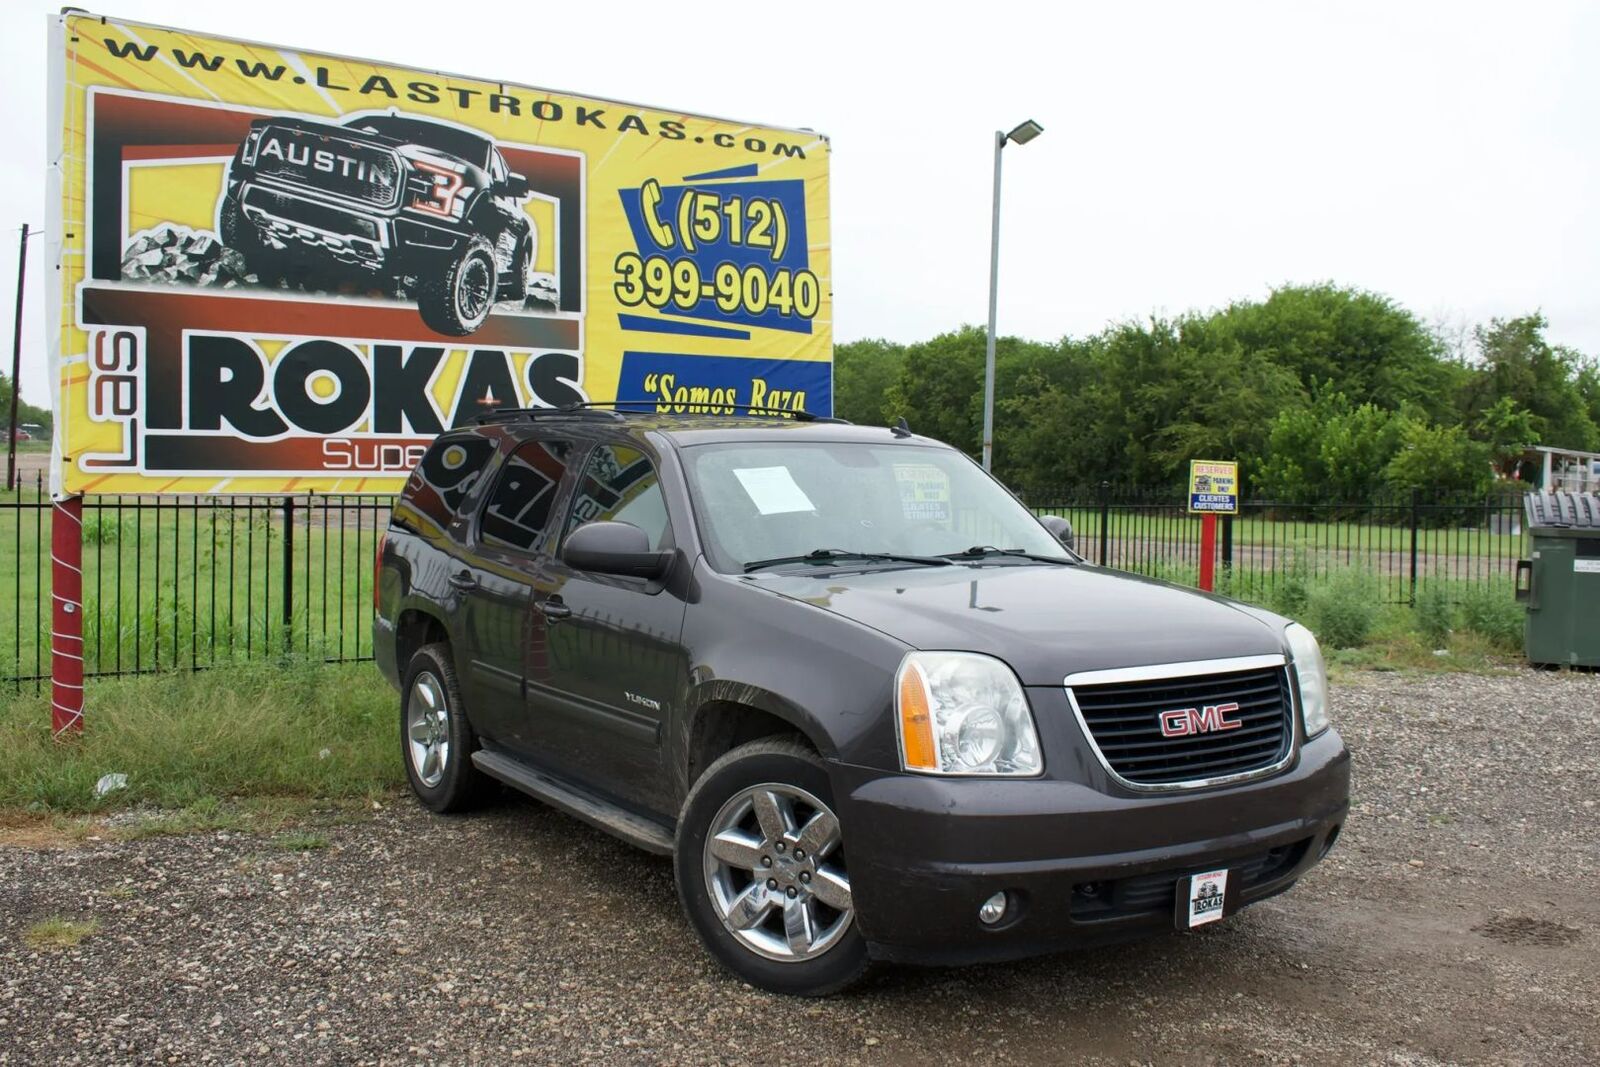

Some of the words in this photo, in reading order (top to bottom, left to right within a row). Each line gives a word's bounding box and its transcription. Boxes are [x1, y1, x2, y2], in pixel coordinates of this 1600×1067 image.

[260, 137, 392, 187] AUSTIN
[677, 187, 788, 262] (512)
[613, 251, 820, 319] 399-9040
[82, 287, 585, 434] TROKAS
[1195, 465, 1233, 475] RESERVED
[1213, 477, 1234, 485] PARKING
[1193, 502, 1234, 510] CUSTOMERS
[1198, 494, 1230, 503] CLIENTES
[623, 691, 661, 711] YUKON
[1158, 701, 1242, 737] GMC
[1191, 895, 1223, 912] TROKAS
